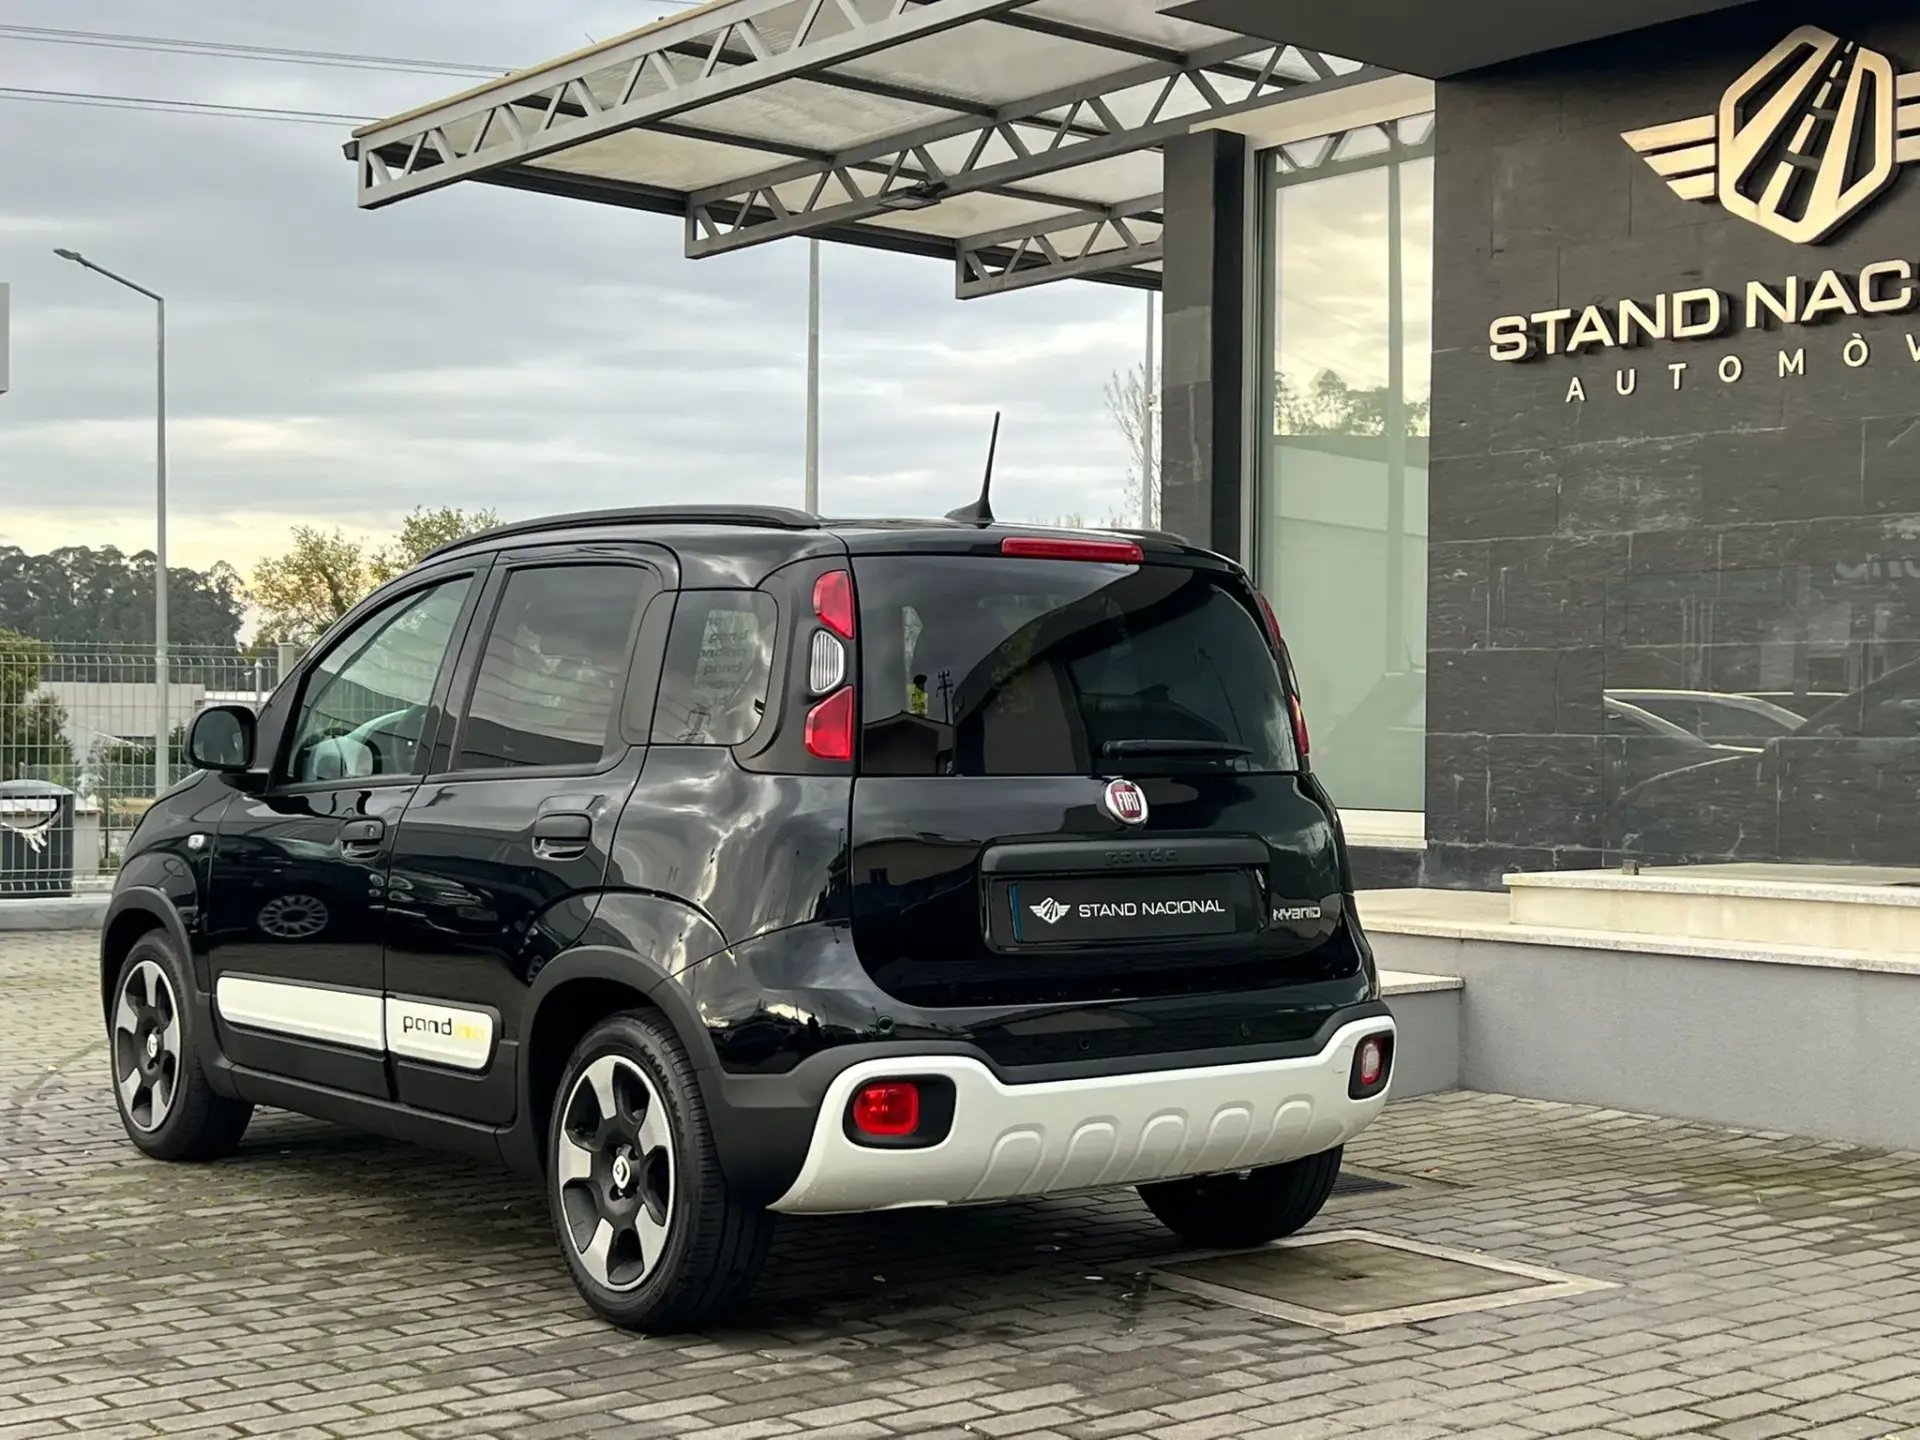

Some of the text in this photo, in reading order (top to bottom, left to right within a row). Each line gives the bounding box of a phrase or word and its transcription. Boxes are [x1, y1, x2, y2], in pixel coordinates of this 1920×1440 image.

[1489, 288, 1720, 362] STAND
[1115, 791, 1140, 812] FIAT
[1078, 899, 1226, 918] STAND NACIONAL
[402, 1015, 485, 1041] pand
